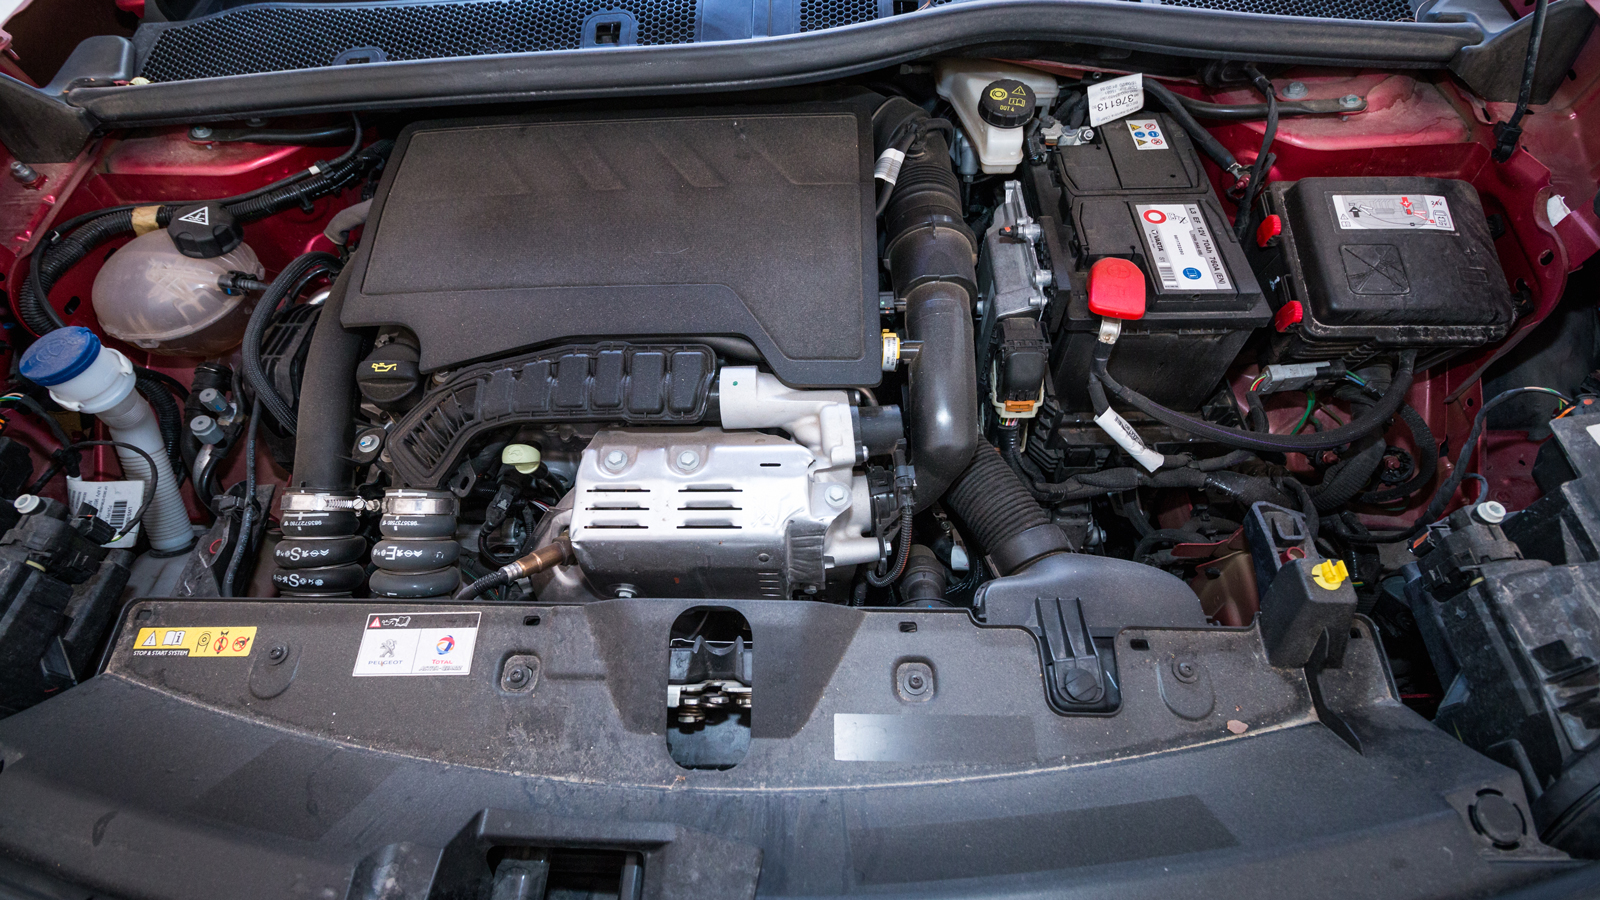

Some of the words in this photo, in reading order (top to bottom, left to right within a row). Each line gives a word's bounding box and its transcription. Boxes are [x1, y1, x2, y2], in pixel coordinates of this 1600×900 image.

[1096, 94, 1134, 111] 376113
[1153, 233, 1164, 252] VARTA
[1193, 216, 1200, 224] EF
[1197, 226, 1206, 238] 12V
[1202, 239, 1213, 254] 70Ah
[290, 547, 301, 561] S
[386, 546, 398, 561] E
[288, 573, 300, 587] S
